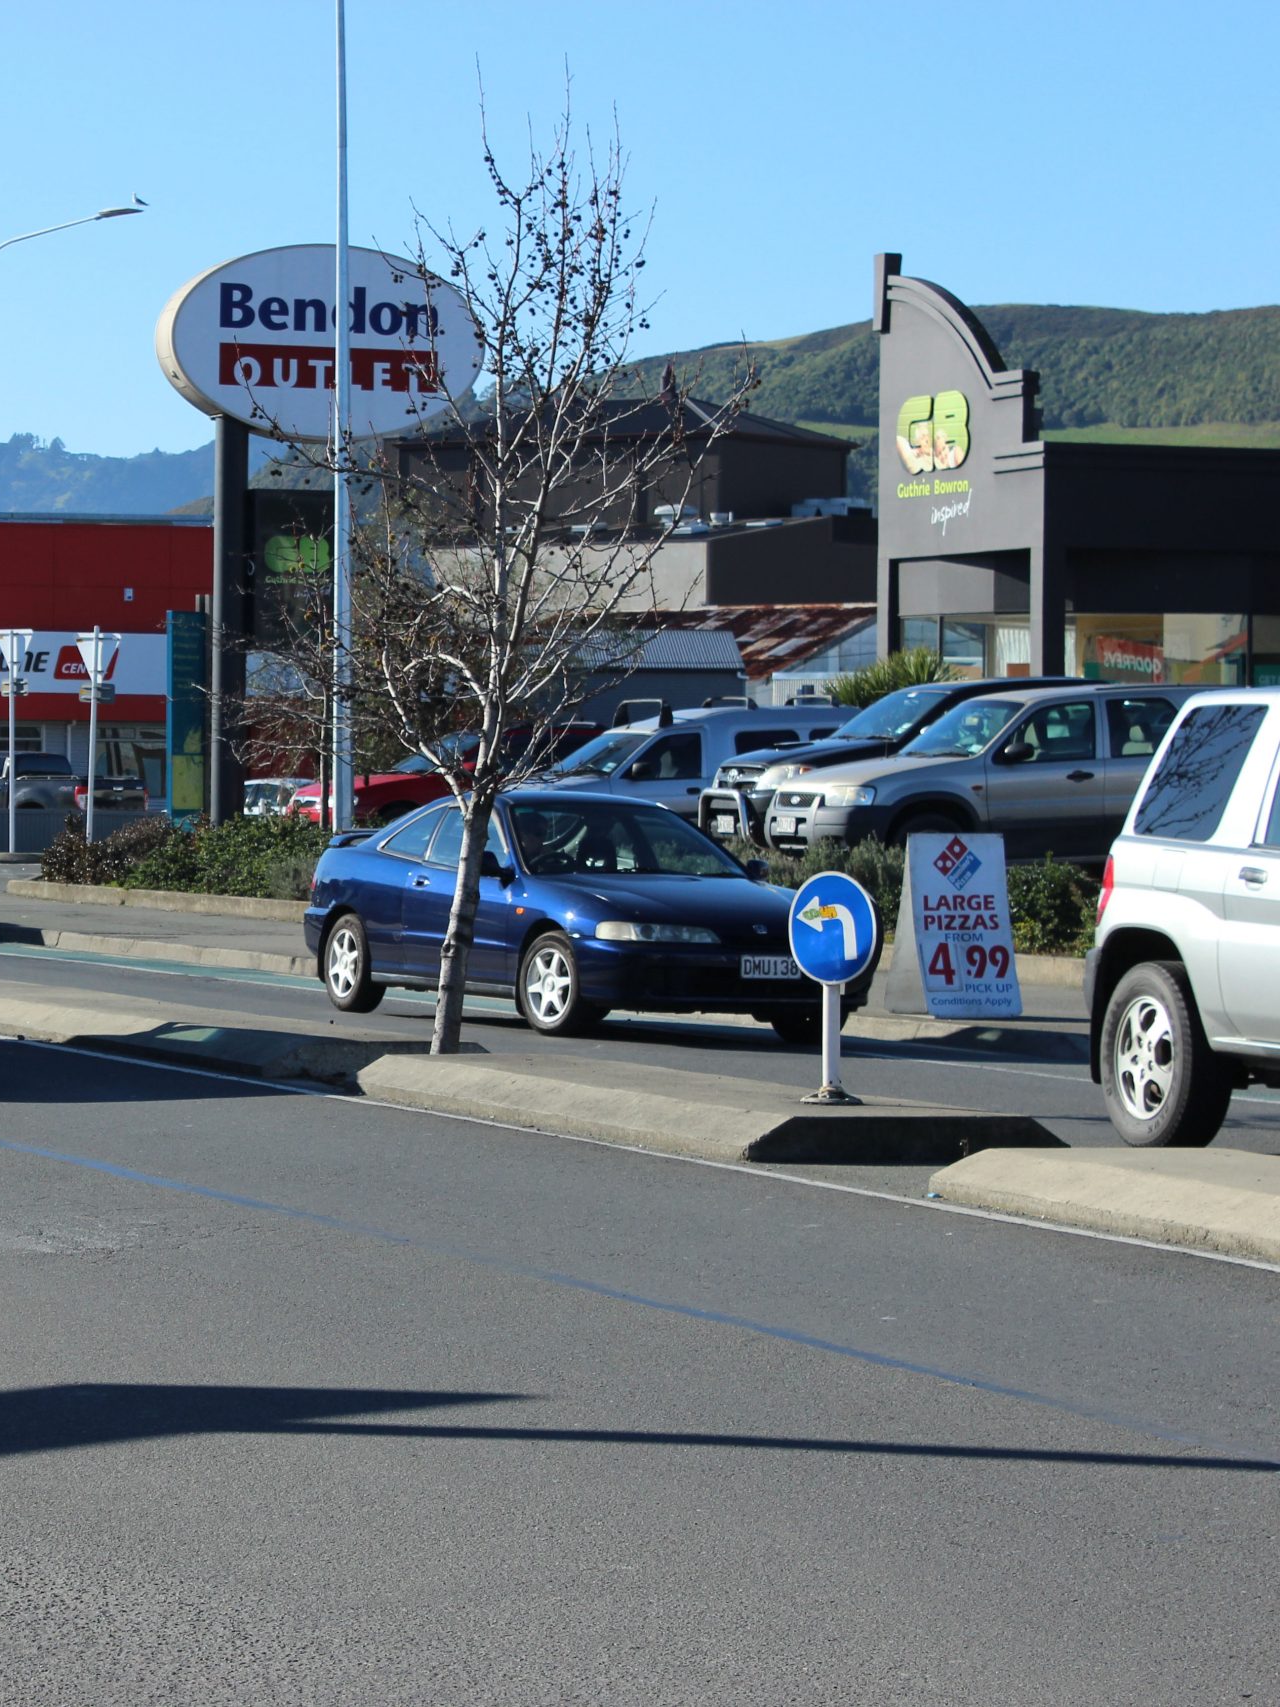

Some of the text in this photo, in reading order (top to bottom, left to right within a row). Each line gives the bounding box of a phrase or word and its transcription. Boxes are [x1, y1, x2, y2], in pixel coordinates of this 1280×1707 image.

[219, 281, 439, 338] Bendon
[233, 355, 431, 392] OUTLET
[897, 478, 969, 498] Guthrie Bowron
[930, 487, 973, 537] inspired
[923, 894, 996, 912] LARGE
[923, 914, 1000, 932] PIZZAS
[944, 932, 984, 943] FROM
[743, 959, 799, 977] DMU138
[964, 983, 1013, 994] PICK UP
[931, 996, 1013, 1008] Conditions Apply
